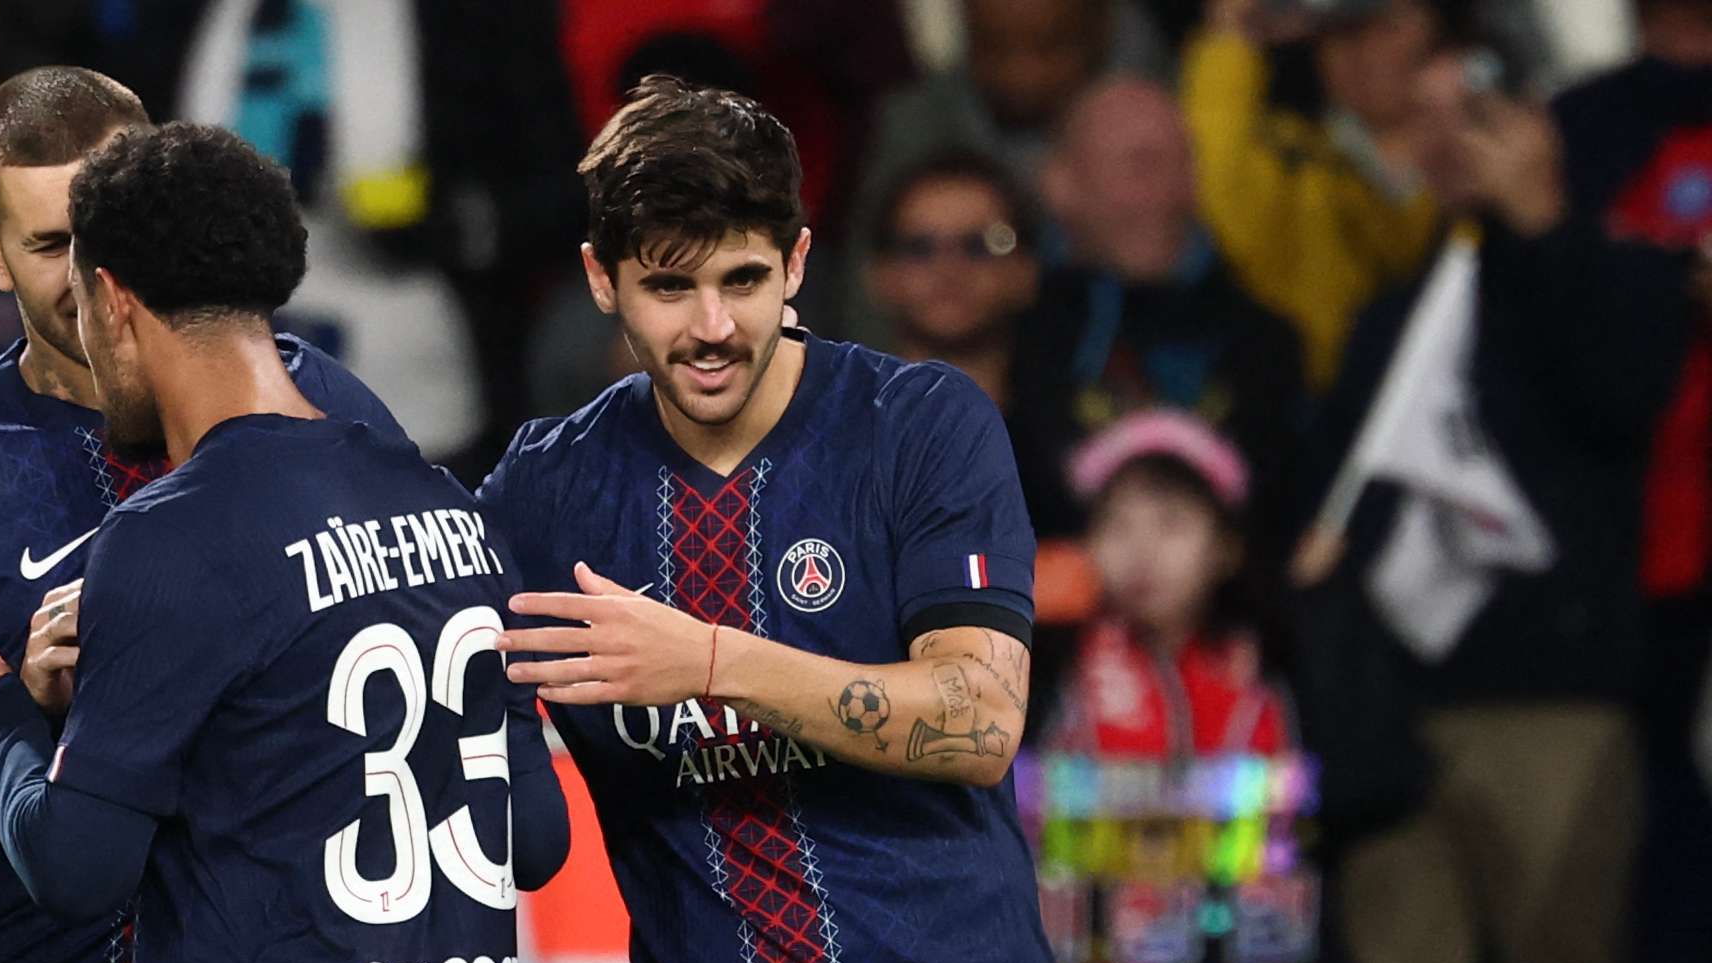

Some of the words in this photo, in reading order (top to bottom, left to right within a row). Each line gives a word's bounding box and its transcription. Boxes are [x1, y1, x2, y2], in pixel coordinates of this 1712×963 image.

[787, 542, 830, 564] PARIS
[324, 605, 518, 925] 33
[675, 736, 827, 788] AIRWA
